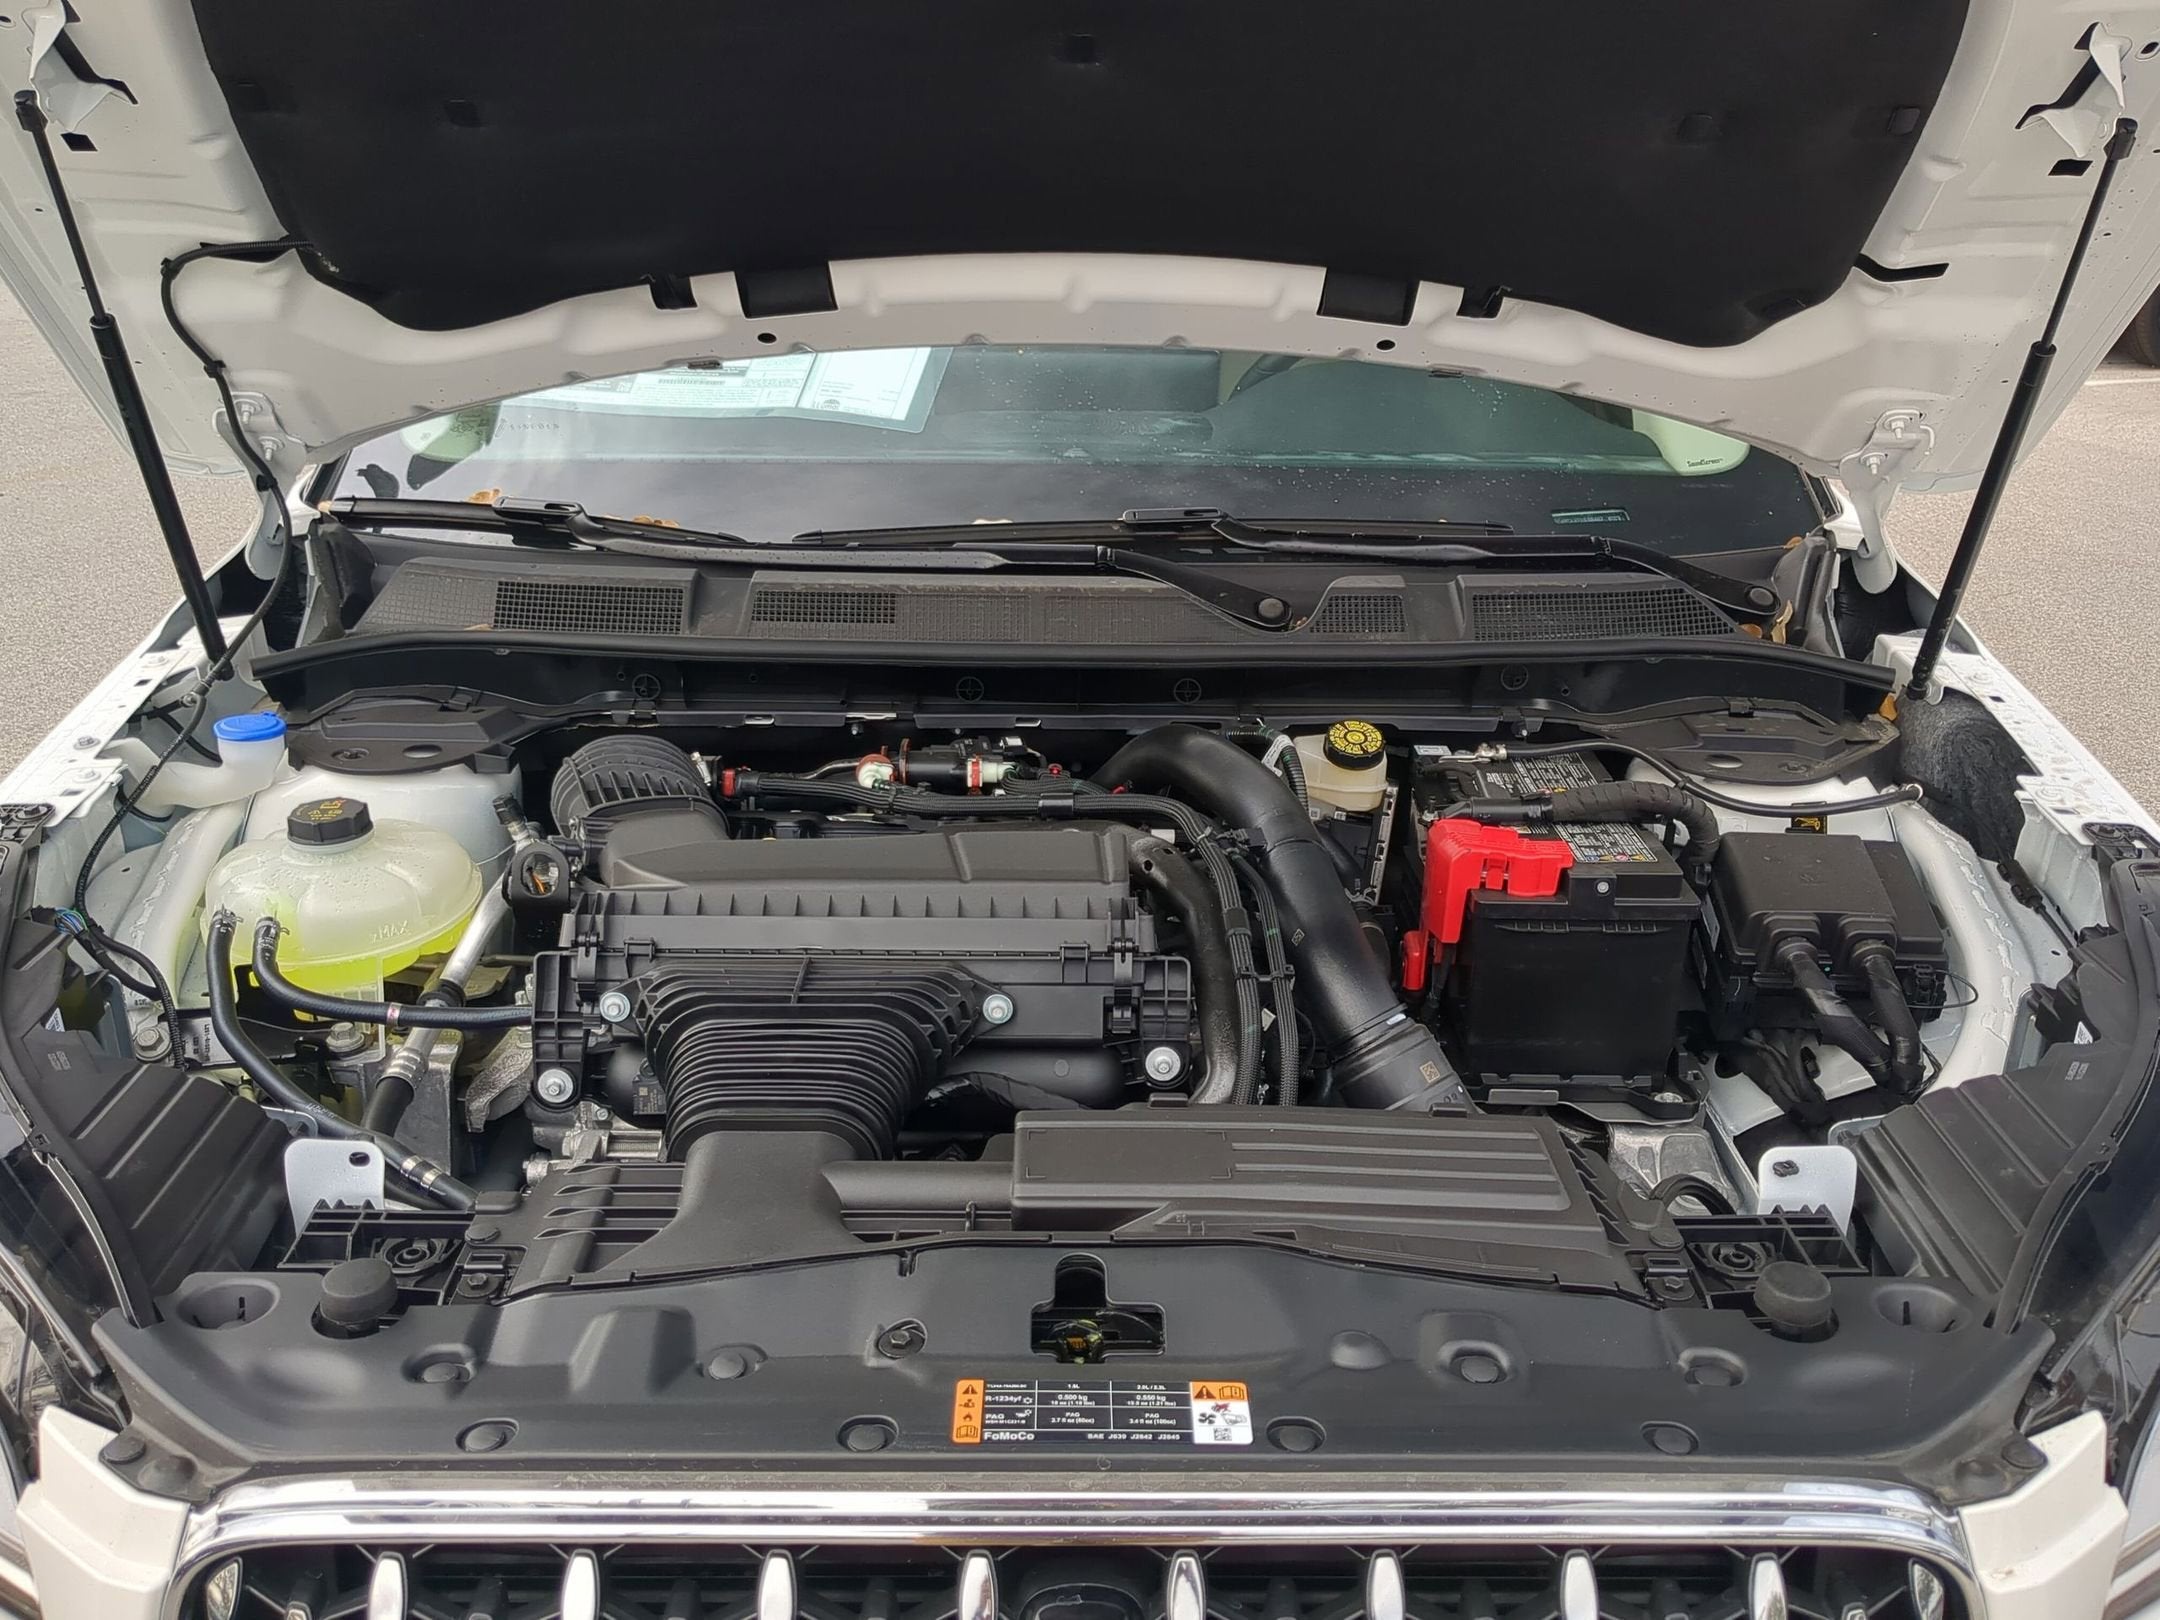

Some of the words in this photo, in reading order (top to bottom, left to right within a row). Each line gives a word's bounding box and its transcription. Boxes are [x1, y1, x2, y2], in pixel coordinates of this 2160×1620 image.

[378, 920, 411, 939] MAX
[985, 1395, 1022, 1403] R-1234yf
[1078, 1394, 1088, 1402] kg
[1156, 1394, 1166, 1402] kg
[984, 1431, 1035, 1440] FoMoCo
